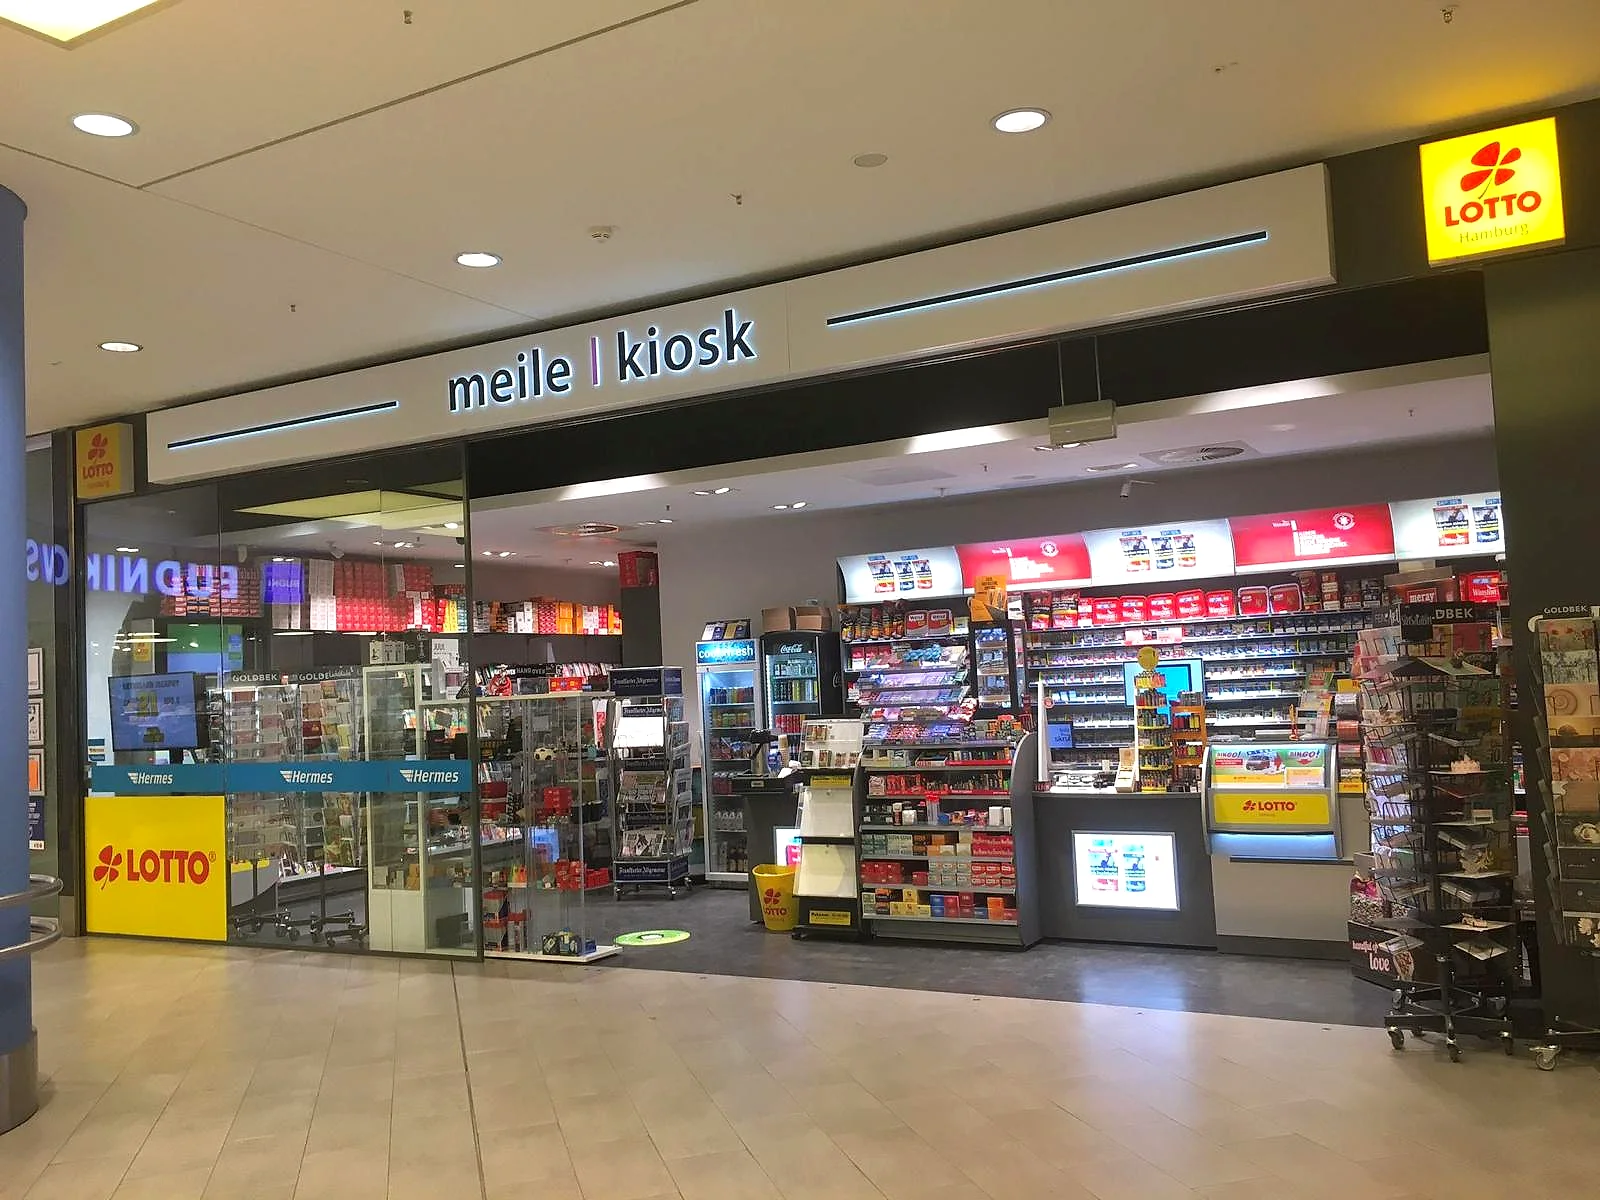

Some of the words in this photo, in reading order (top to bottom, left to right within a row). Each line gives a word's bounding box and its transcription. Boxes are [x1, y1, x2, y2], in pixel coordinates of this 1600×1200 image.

[1445, 191, 1541, 227] LOTTO
[1459, 223, 1530, 244] Hamburg
[449, 348, 572, 412] meile
[617, 309, 756, 382] kiosk
[82, 462, 114, 480] LOTTO
[1543, 605, 1589, 615] GOLDBEK
[232, 673, 278, 682] GOLDBEK
[138, 772, 173, 786] Hermes
[292, 770, 333, 784] Hermes
[412, 769, 459, 783] Hermes
[1258, 801, 1296, 812] LOTTO
[1369, 952, 1390, 972] love
